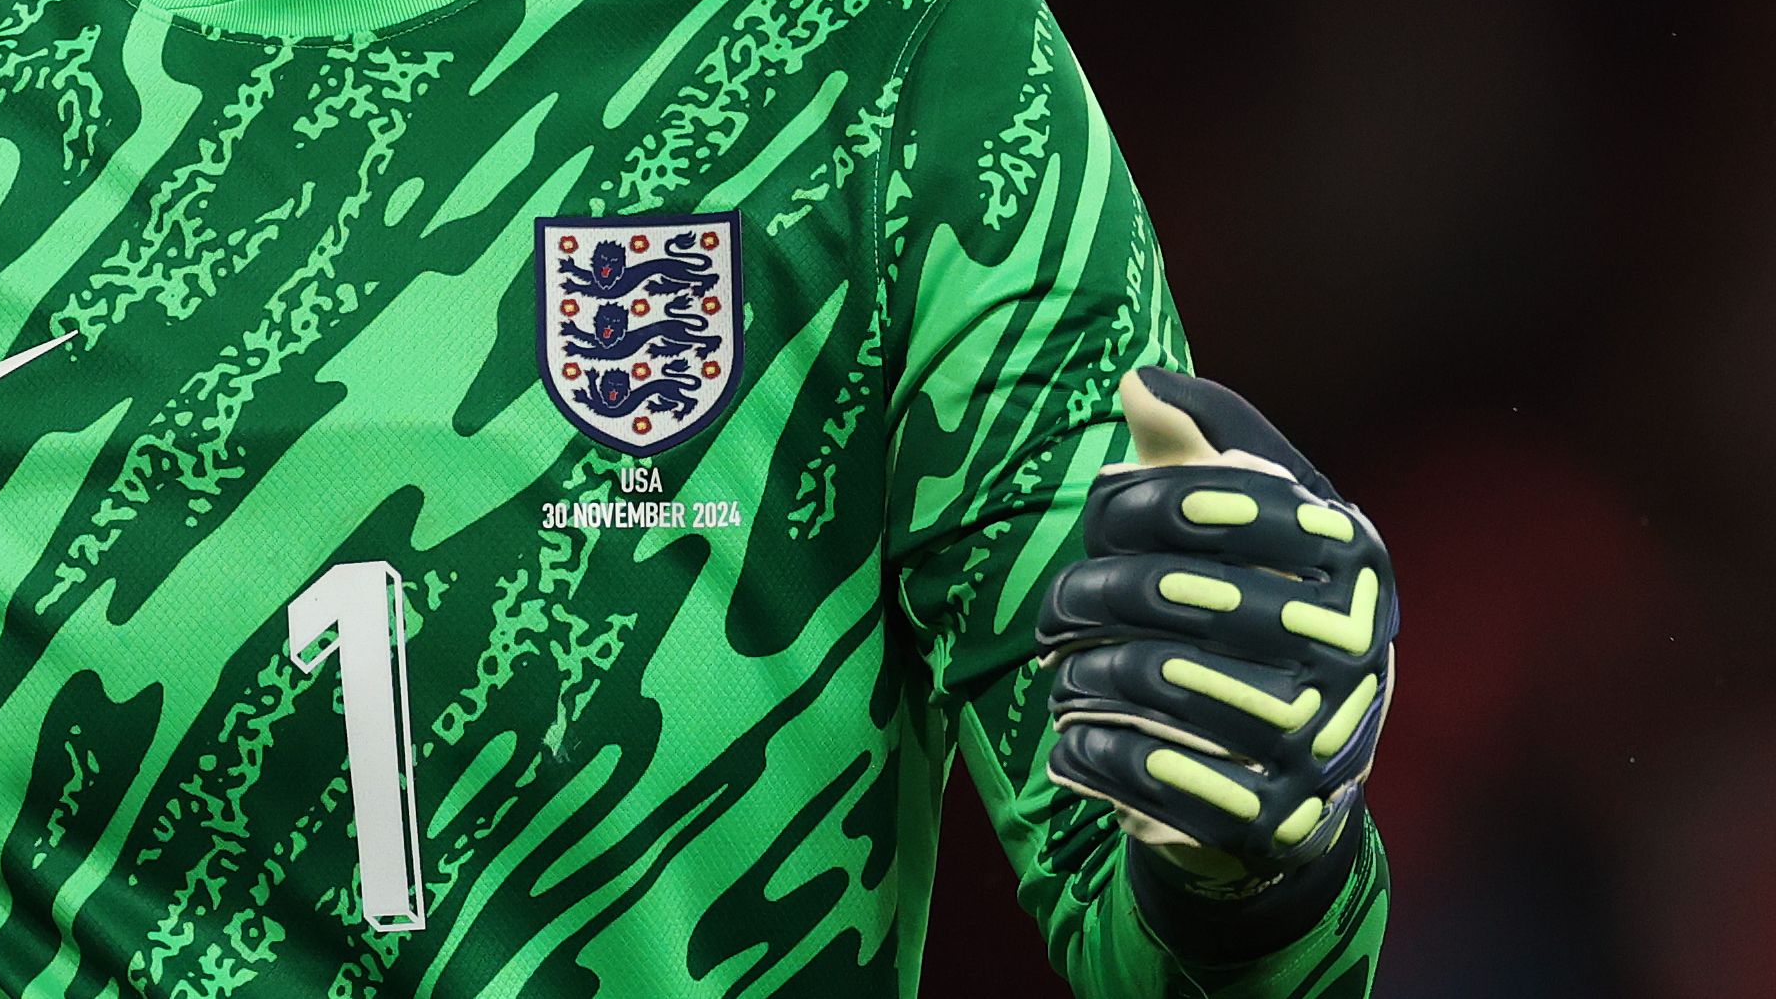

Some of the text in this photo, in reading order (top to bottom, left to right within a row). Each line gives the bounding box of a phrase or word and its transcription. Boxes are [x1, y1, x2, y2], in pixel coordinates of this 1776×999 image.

[620, 467, 663, 493] USA
[542, 501, 741, 528] 30 NOVEMBER 2024
[287, 561, 425, 932] 1
